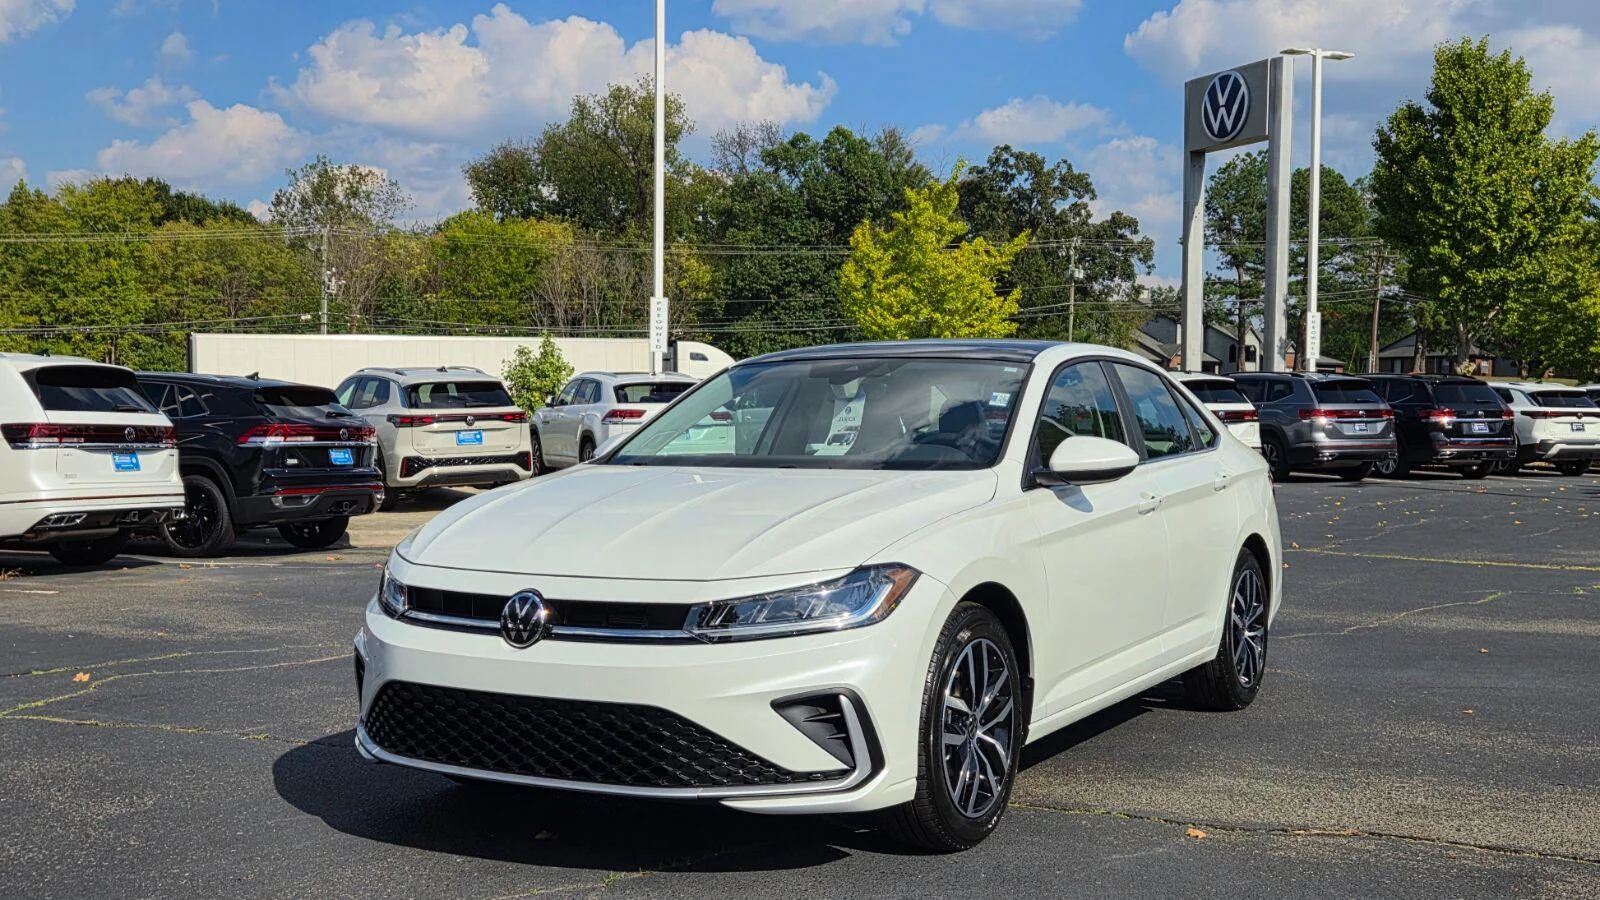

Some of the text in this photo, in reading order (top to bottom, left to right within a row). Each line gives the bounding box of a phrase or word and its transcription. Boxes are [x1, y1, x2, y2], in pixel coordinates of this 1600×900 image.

[1202, 71, 1249, 141] VW
[655, 300, 664, 350] PREOWNED
[501, 591, 545, 647] VW
